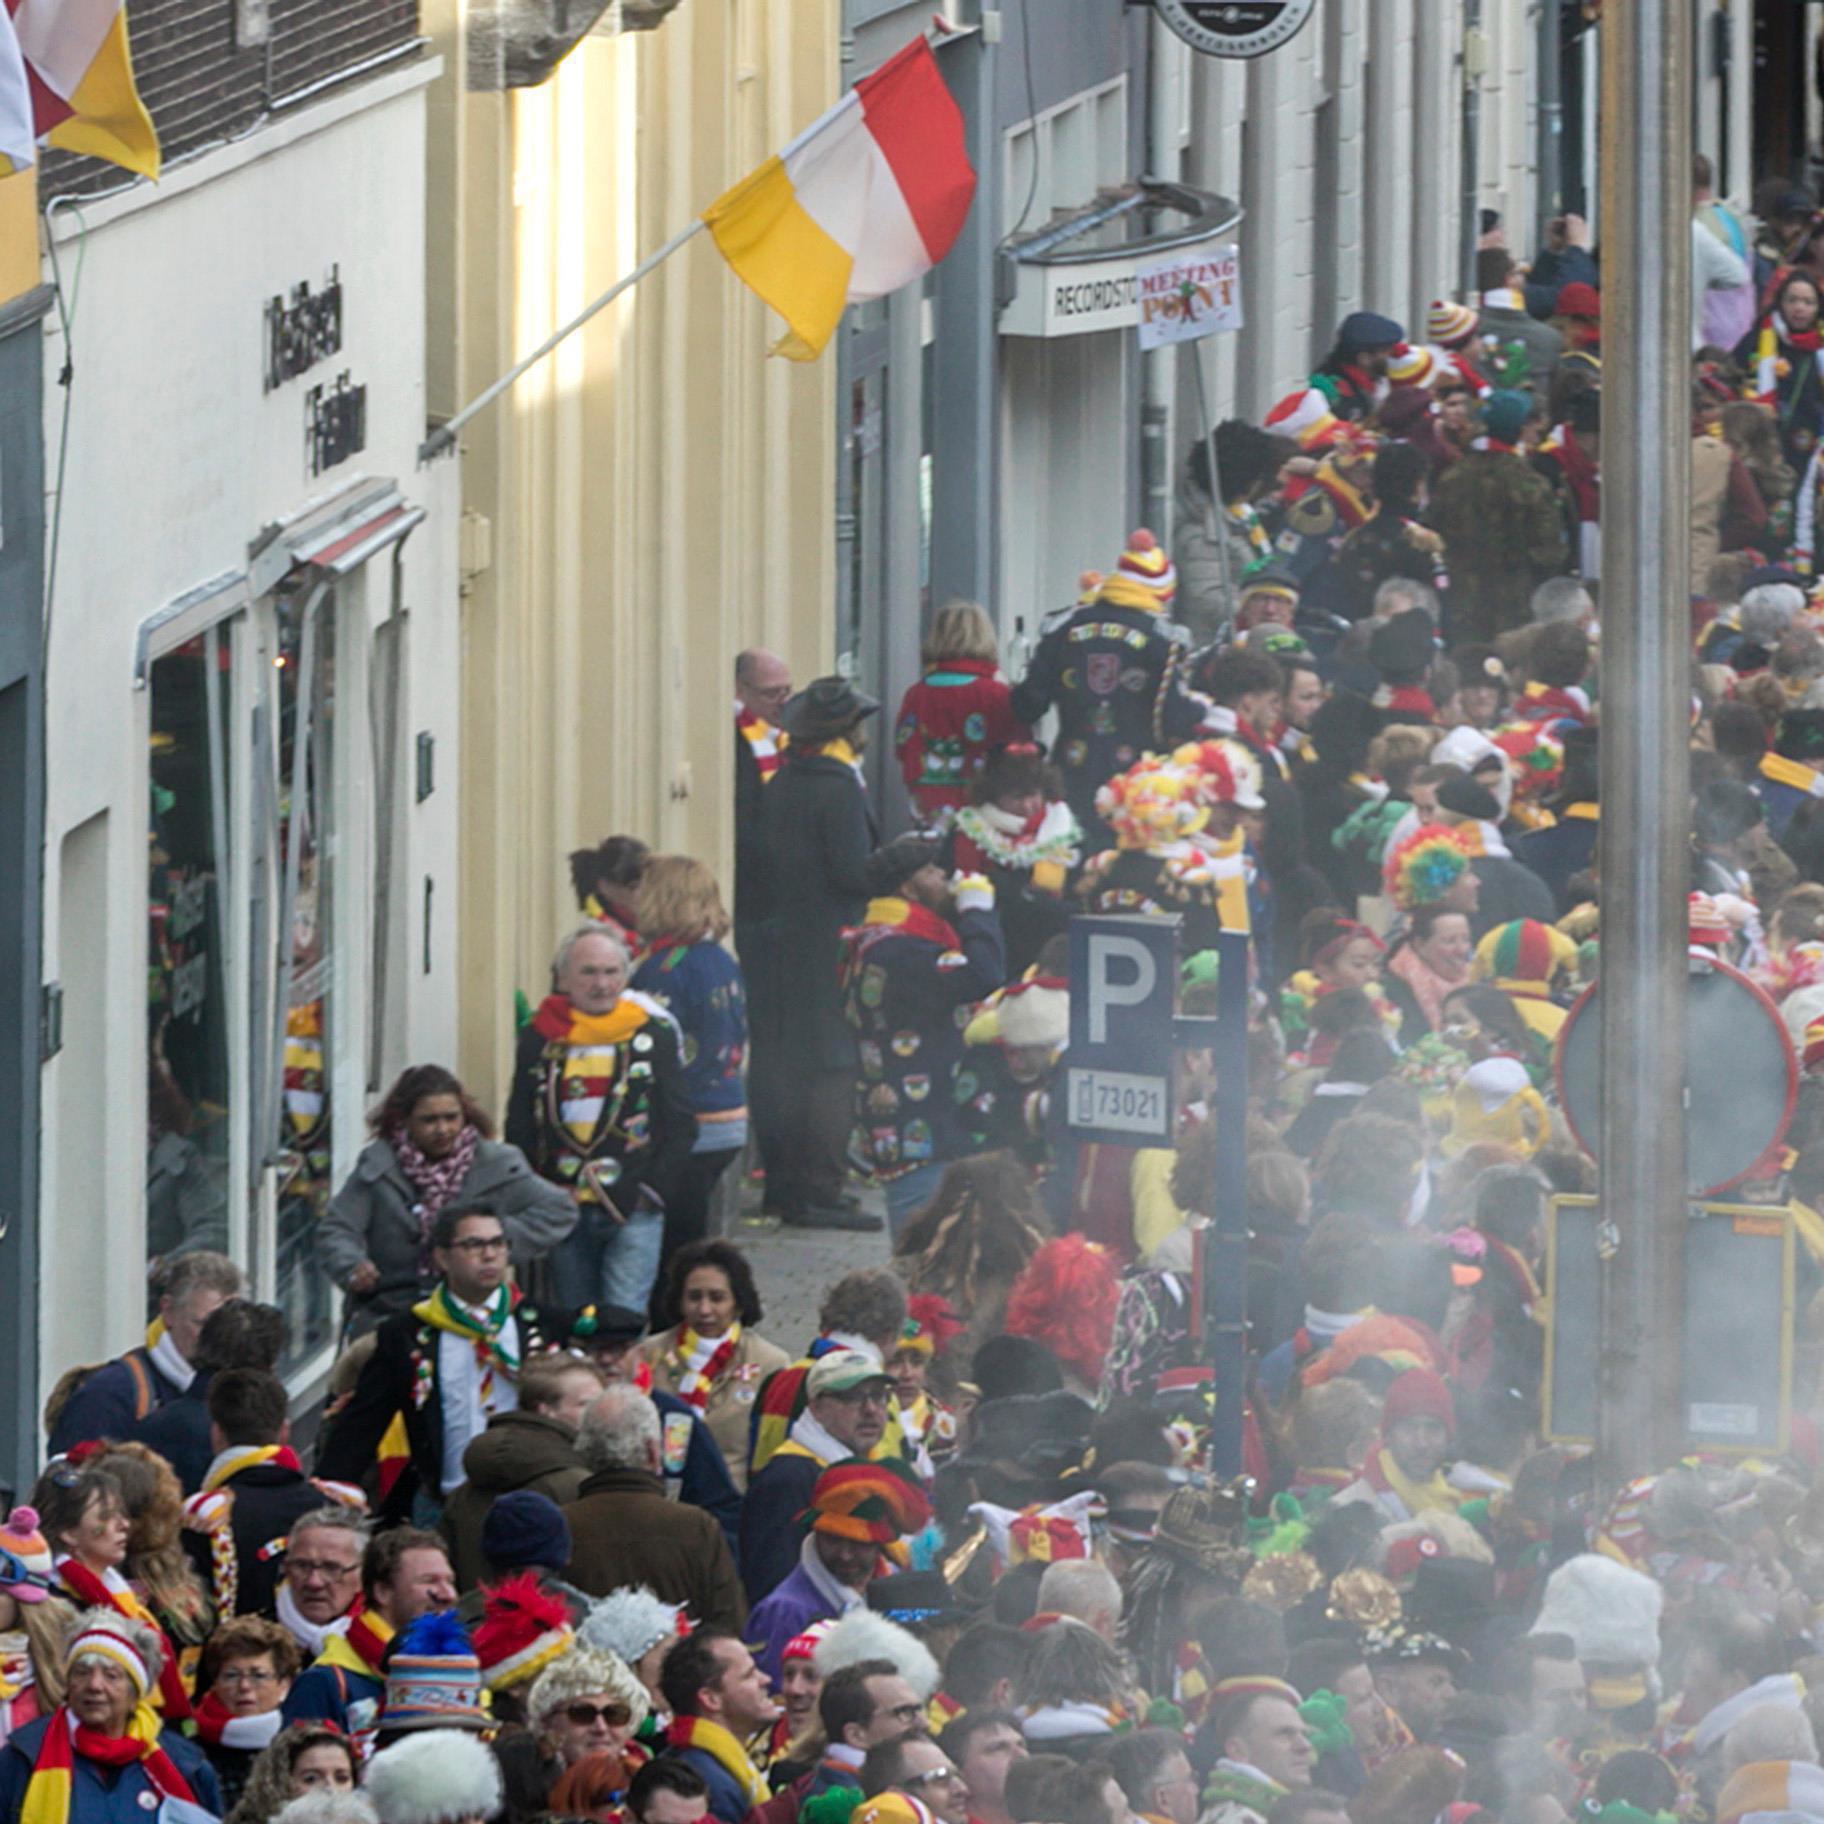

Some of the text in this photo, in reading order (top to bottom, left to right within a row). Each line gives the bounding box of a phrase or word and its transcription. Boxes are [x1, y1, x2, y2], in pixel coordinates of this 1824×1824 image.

[1141, 258, 1234, 295] MEETING
[1088, 934, 1156, 1044] P
[1097, 1085, 1159, 1118] 73021
